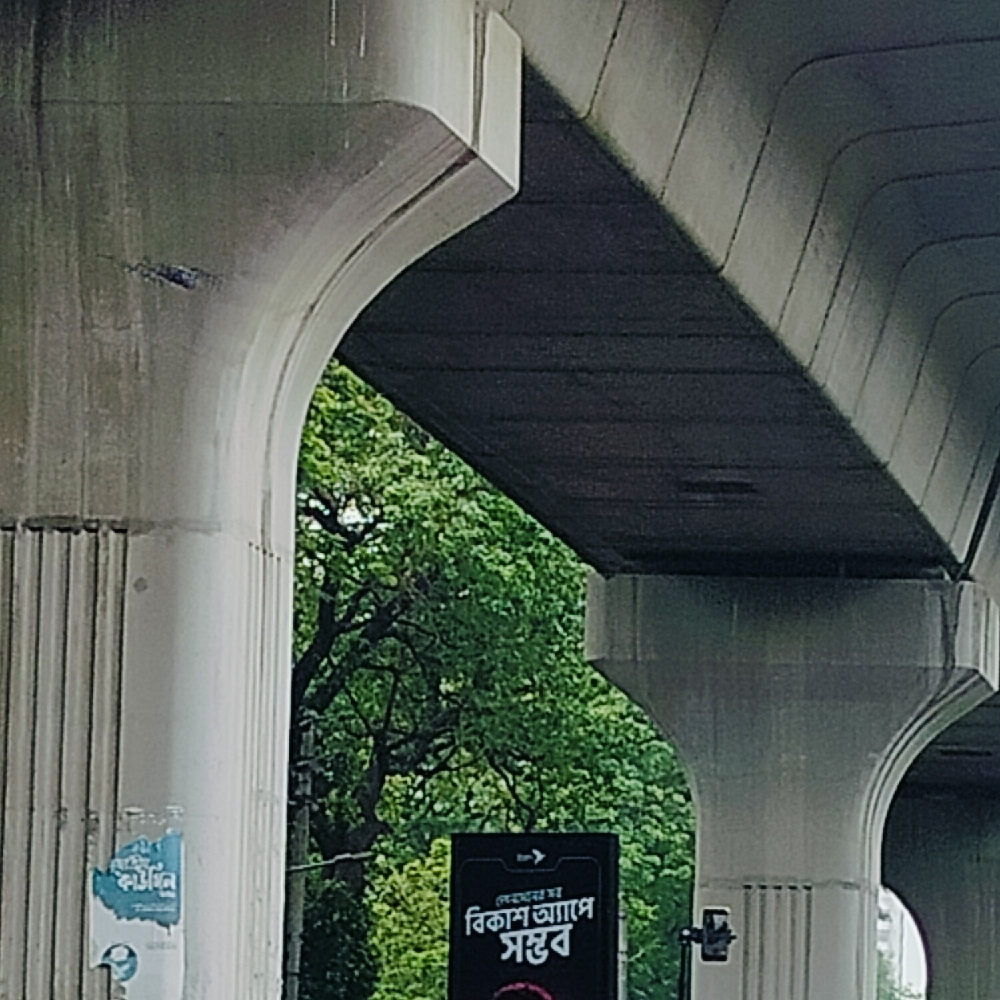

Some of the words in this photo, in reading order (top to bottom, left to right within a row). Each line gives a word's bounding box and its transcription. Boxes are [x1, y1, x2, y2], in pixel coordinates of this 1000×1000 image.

[465, 905, 530, 936] বিকাশ
[532, 897, 595, 924] অ্যাপে
[499, 923, 574, 966] সম্ভব
